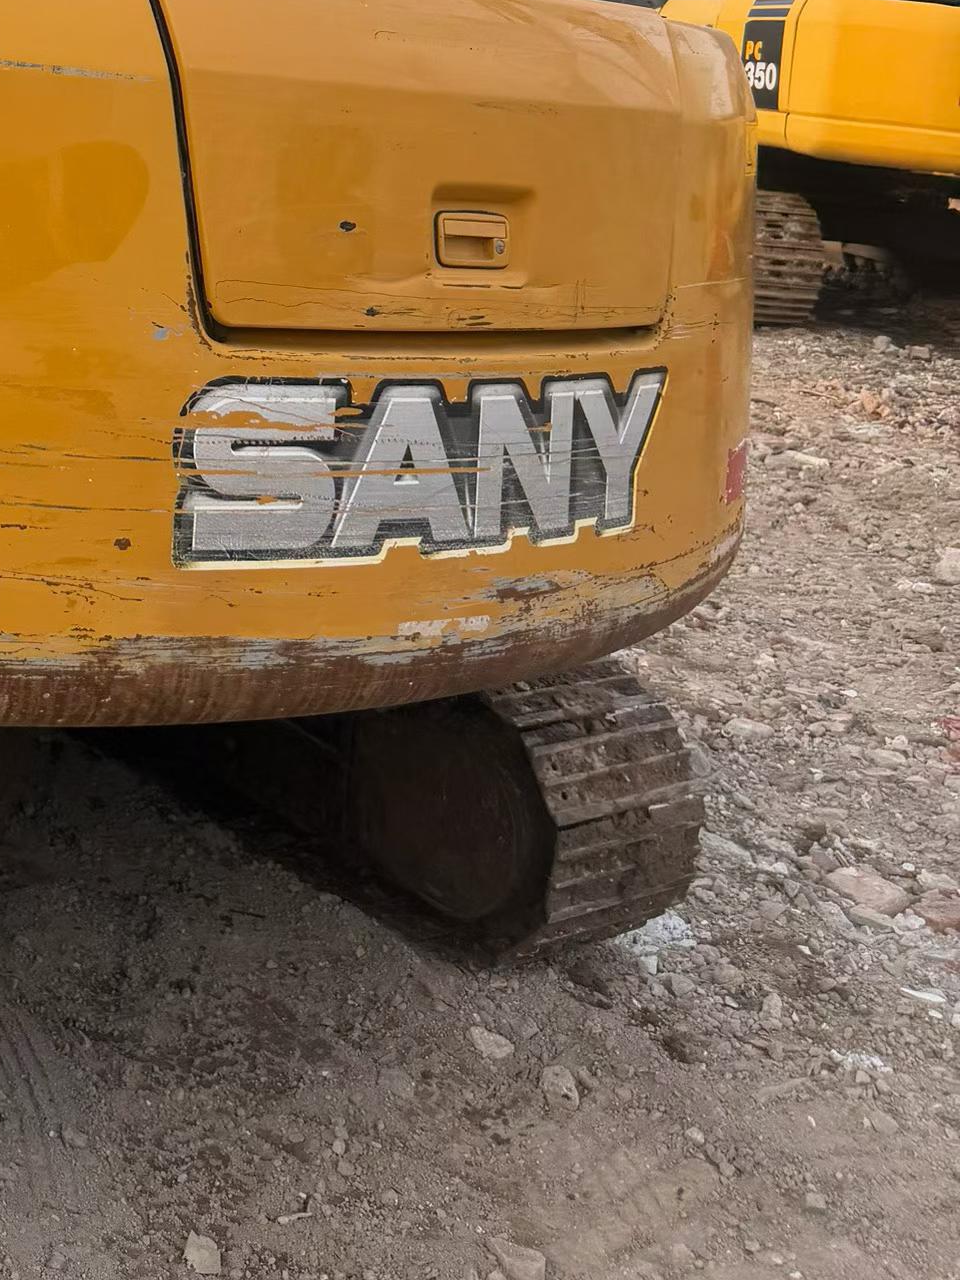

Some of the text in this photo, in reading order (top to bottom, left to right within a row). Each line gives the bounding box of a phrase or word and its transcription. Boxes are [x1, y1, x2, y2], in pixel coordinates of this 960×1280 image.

[745, 40, 763, 61] PC
[744, 61, 777, 90] 350
[173, 367, 668, 568] SANY
